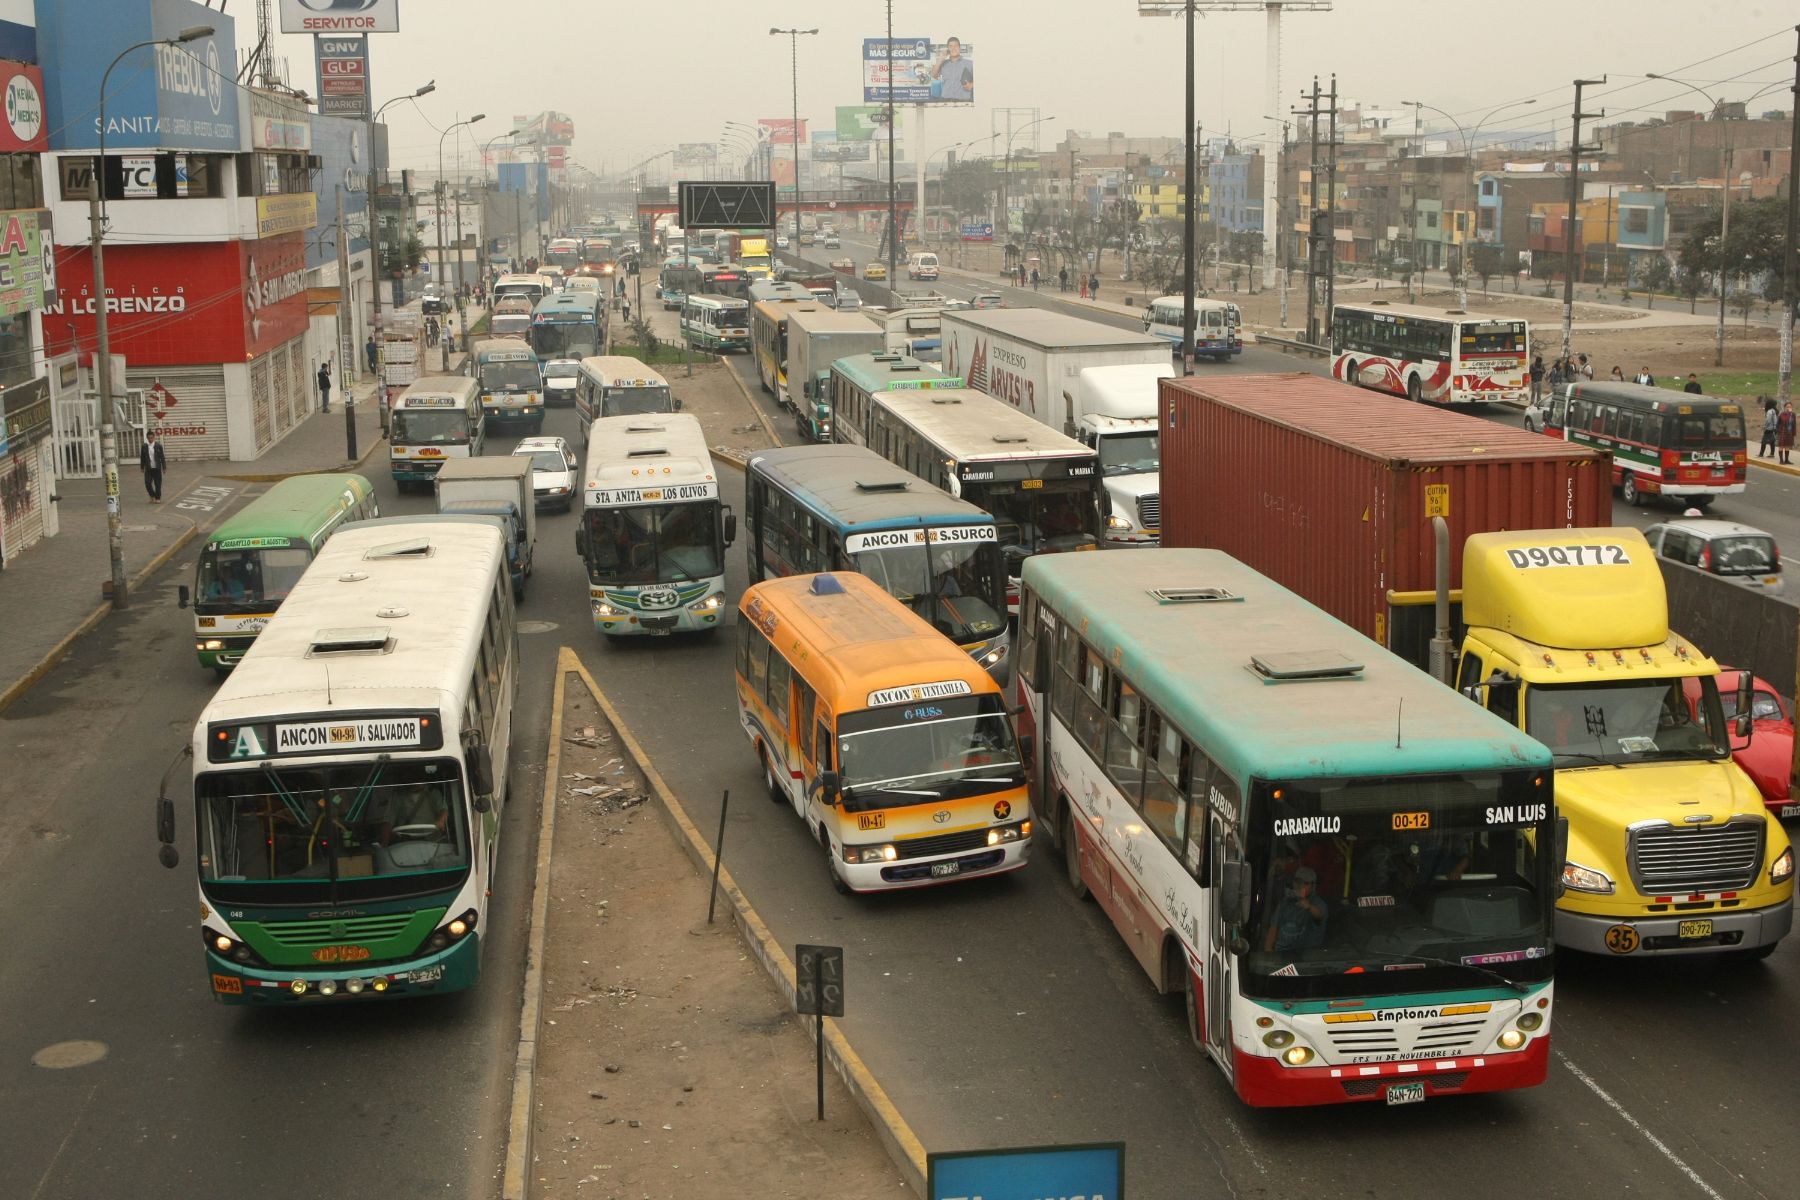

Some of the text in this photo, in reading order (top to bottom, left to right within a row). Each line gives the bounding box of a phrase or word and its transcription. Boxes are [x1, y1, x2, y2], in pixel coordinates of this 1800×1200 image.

[303, 17, 376, 29] SERVITOR
[323, 42, 358, 52] GNV
[153, 42, 206, 97] TREBOL
[327, 61, 357, 73] GLP
[325, 100, 362, 109] MARKET
[262, 278, 278, 306] SAN
[72, 296, 186, 314] LORENZO
[993, 346, 1026, 370] EXPRESO
[615, 491, 642, 503] ANITA
[663, 488, 677, 500] LOS
[680, 485, 708, 498] OLIVOS
[862, 533, 909, 548] ANCON
[1507, 545, 1630, 569] D9Q772
[873, 682, 965, 705] ANCON VENTANILLA
[230, 722, 416, 757] A ANCON SO-93 V. SALVADOR
[1209, 785, 1237, 822] SUBIDA
[1274, 816, 1341, 836] CARABAYLLO
[1486, 807, 1514, 824] SAN
[1518, 804, 1546, 822] LUIS
[1681, 924, 1712, 936] D9Q-772
[1608, 929, 1634, 950] 35
[1376, 1008, 1438, 1023] Emptonsa
[1400, 1051, 1447, 1060] NOVIEMBRE
